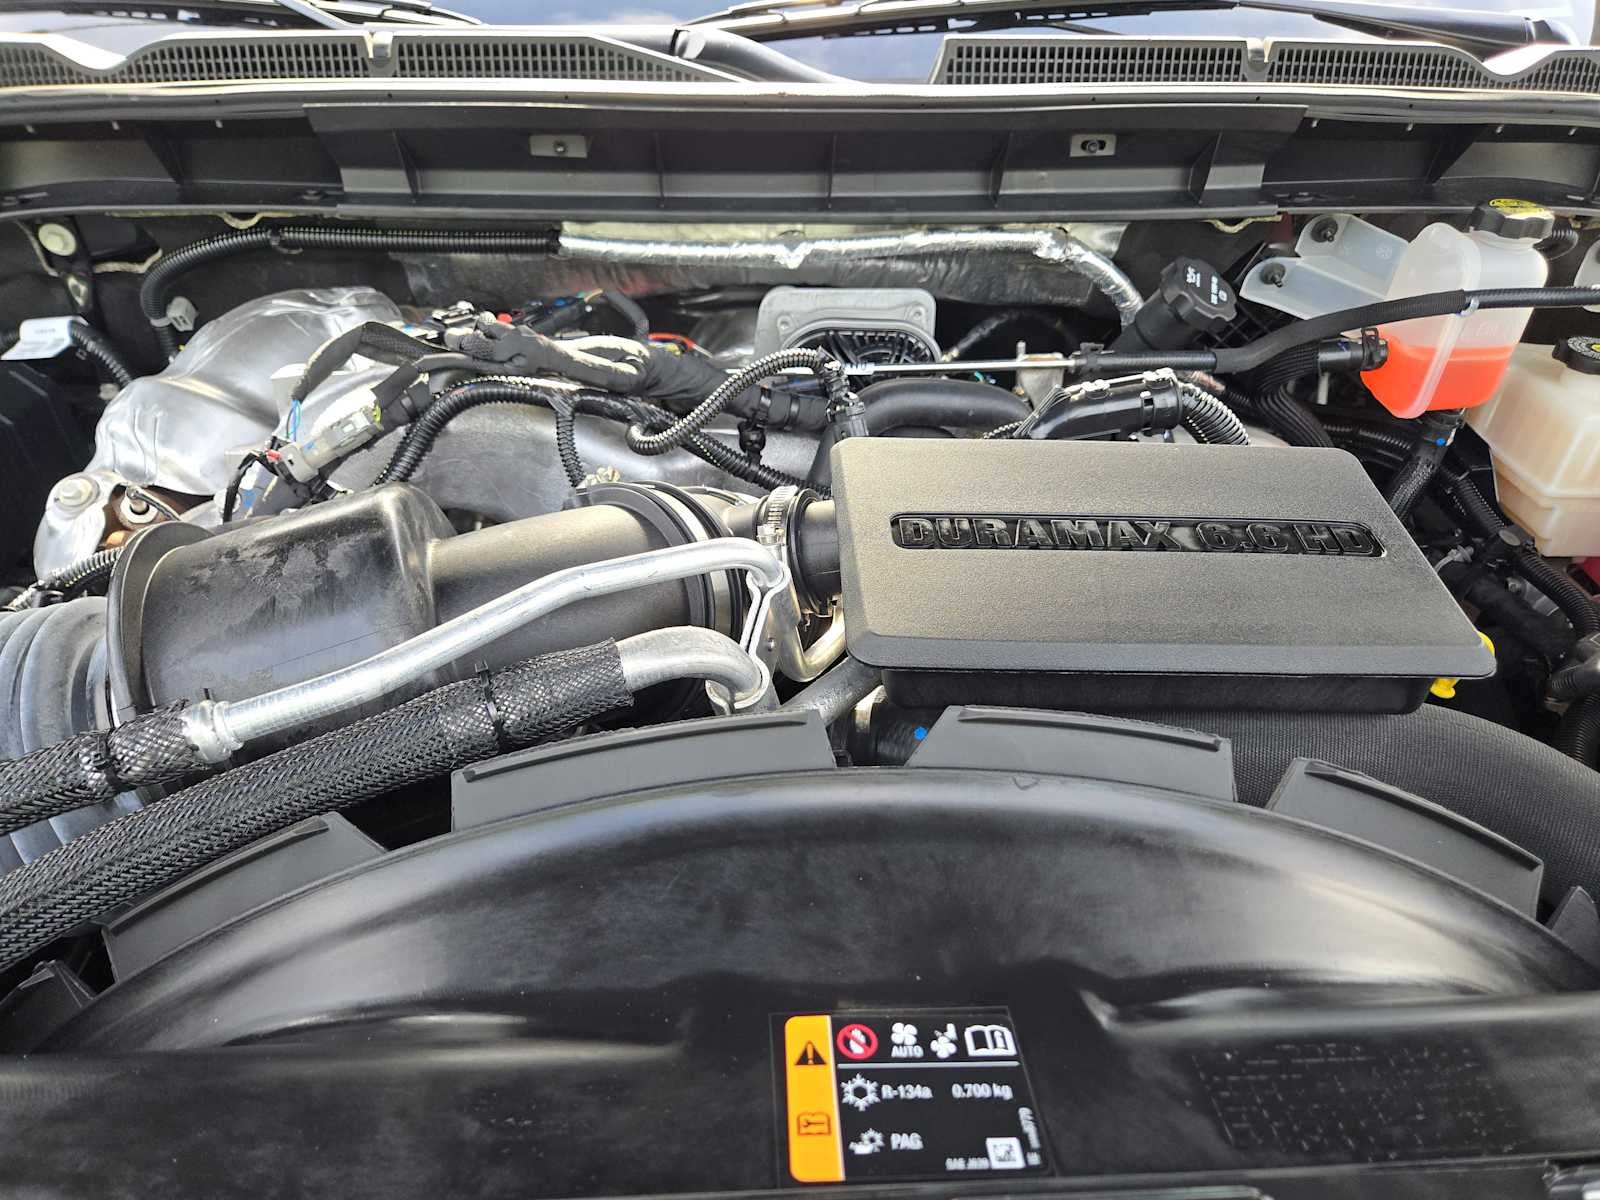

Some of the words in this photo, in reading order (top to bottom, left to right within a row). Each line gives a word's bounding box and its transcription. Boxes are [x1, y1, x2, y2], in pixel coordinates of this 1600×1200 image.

[898, 517, 1182, 551] DURAMAX
[1196, 522, 1288, 552] 6.6
[1292, 524, 1374, 555] HD
[890, 1045, 924, 1058] AUTO
[881, 1083, 934, 1100] R-134a
[951, 1082, 991, 1099] 0.700
[993, 1083, 1014, 1101] kg
[890, 1133, 924, 1150] PAG
